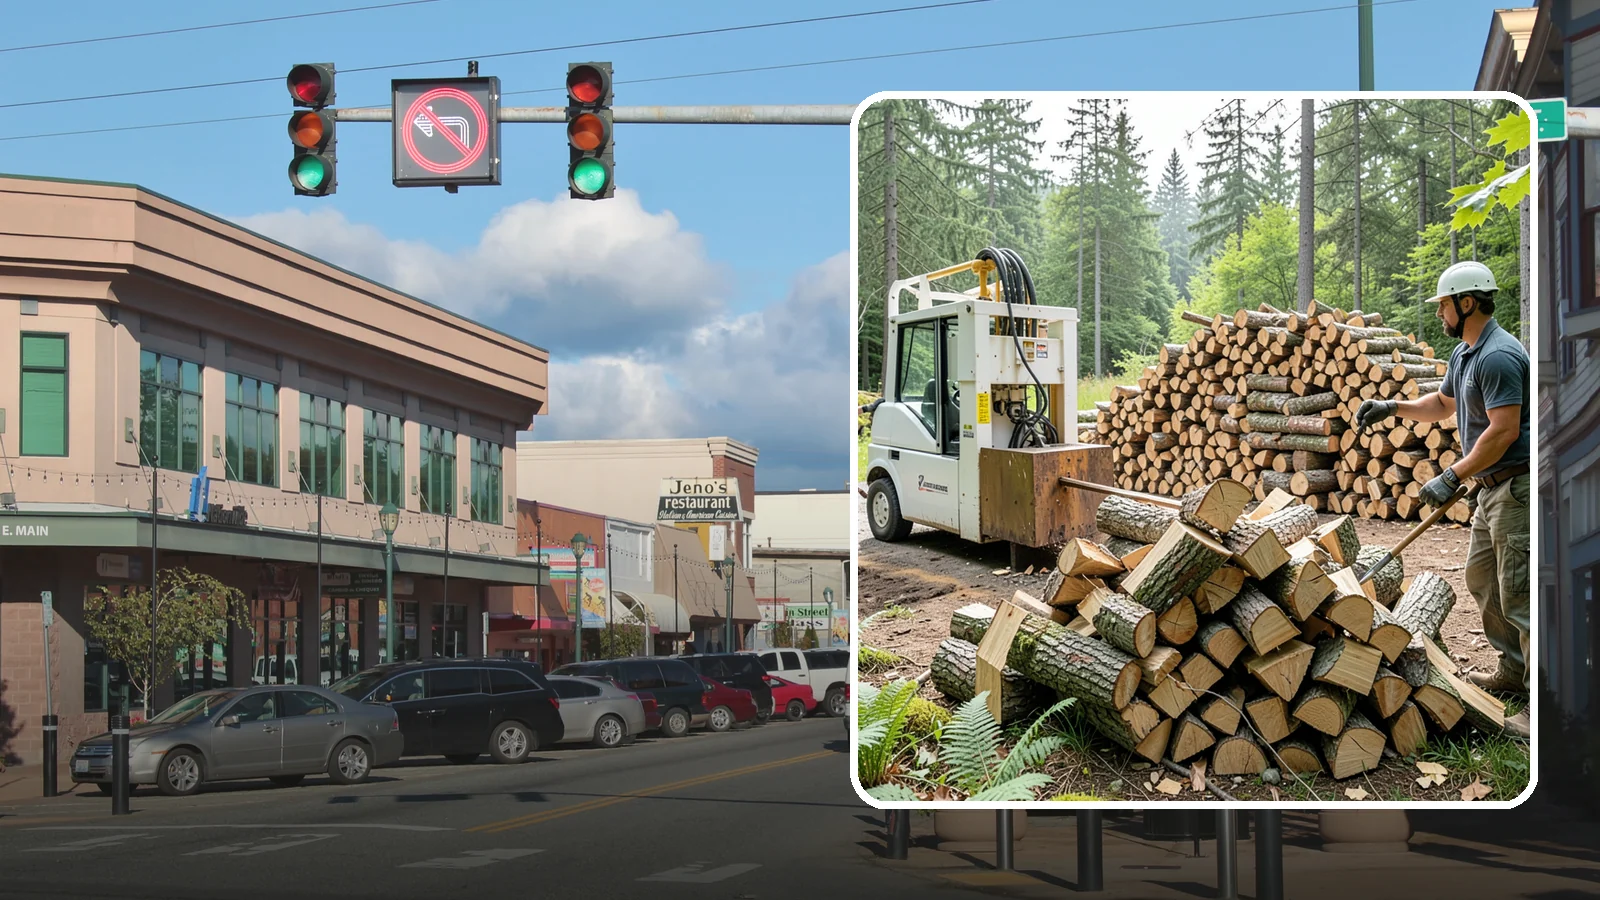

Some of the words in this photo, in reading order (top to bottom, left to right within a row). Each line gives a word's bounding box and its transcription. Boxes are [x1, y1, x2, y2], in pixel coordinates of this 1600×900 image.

[669, 479, 728, 495] Jeno's
[665, 496, 731, 509] restaurant
[686, 509, 714, 519] American
[715, 509, 738, 519] Cuisine
[2, 525, 13, 537] E.
[15, 525, 49, 537] MAIN
[797, 607, 828, 617] Street
